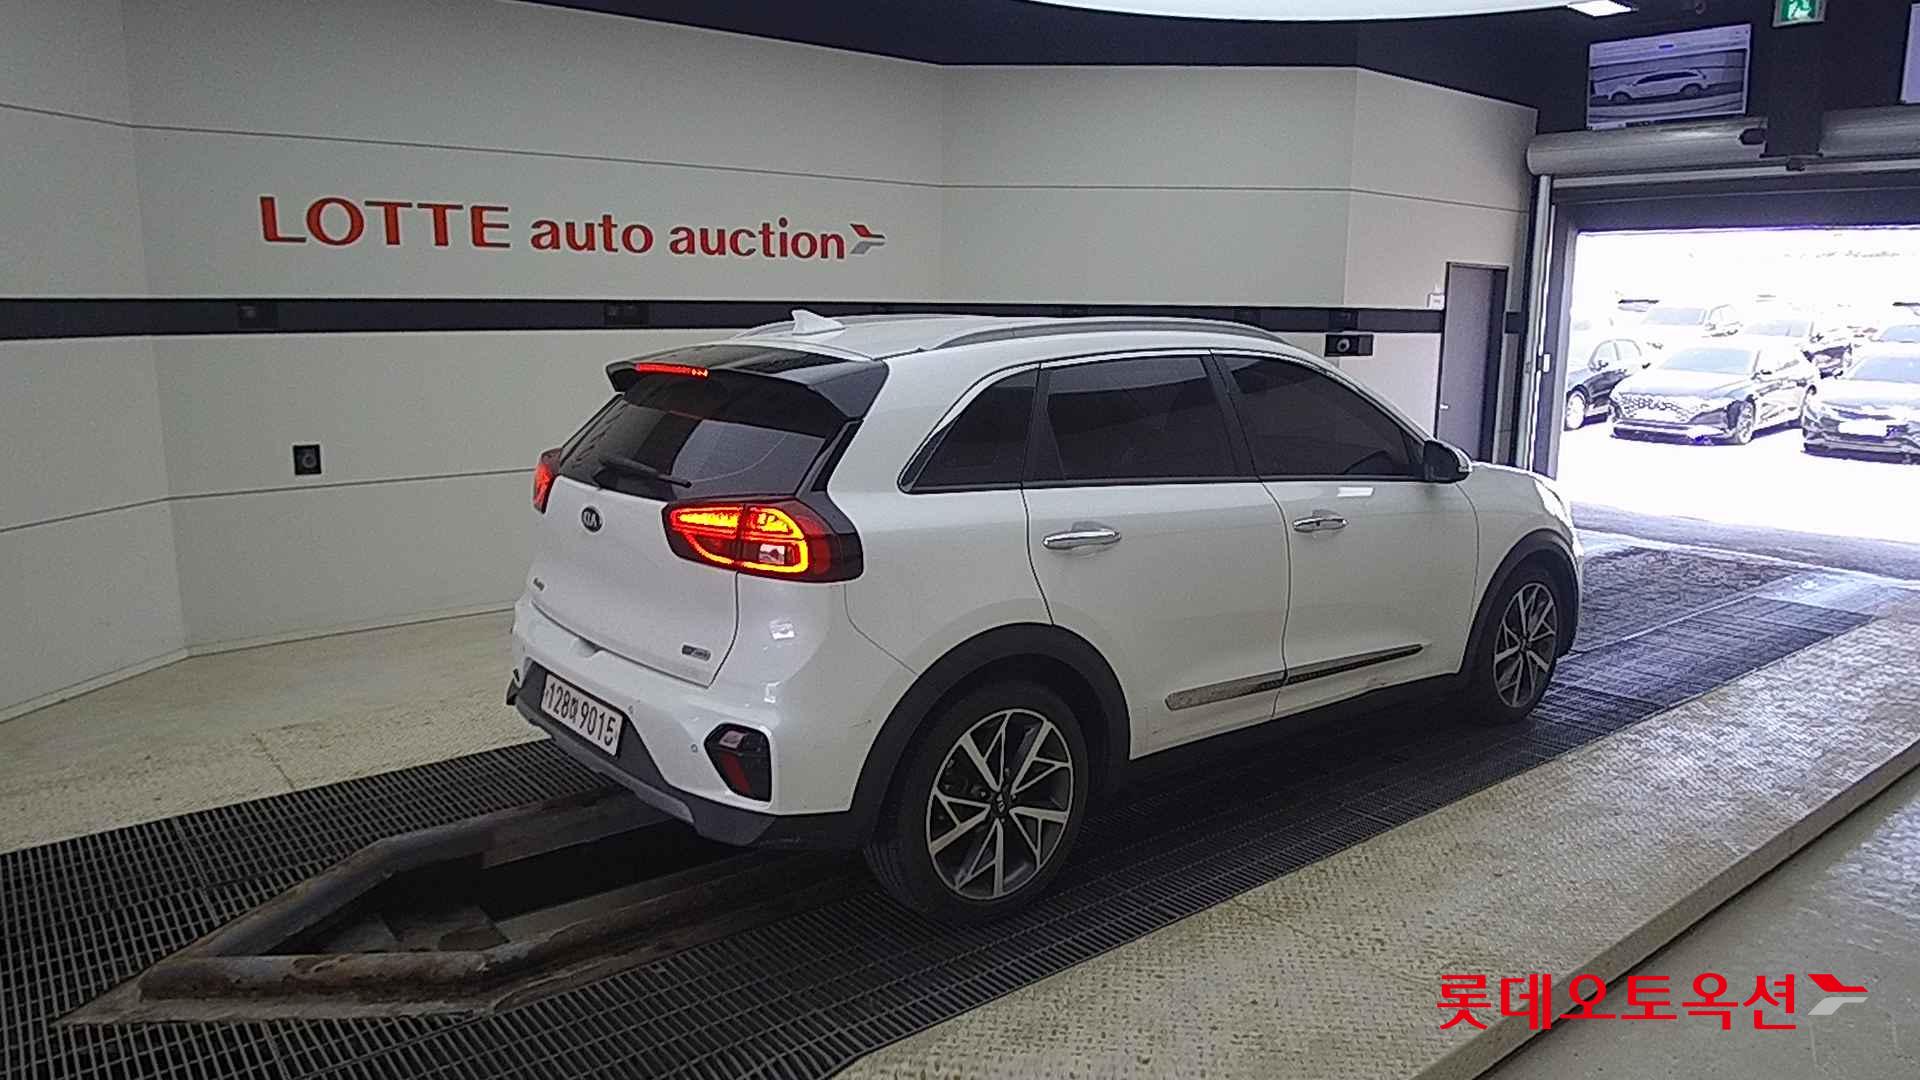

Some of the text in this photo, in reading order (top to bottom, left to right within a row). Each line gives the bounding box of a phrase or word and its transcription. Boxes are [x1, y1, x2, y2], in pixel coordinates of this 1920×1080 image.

[260, 196, 846, 259] LOTTE auto auction
[580, 701, 616, 746] 9015
